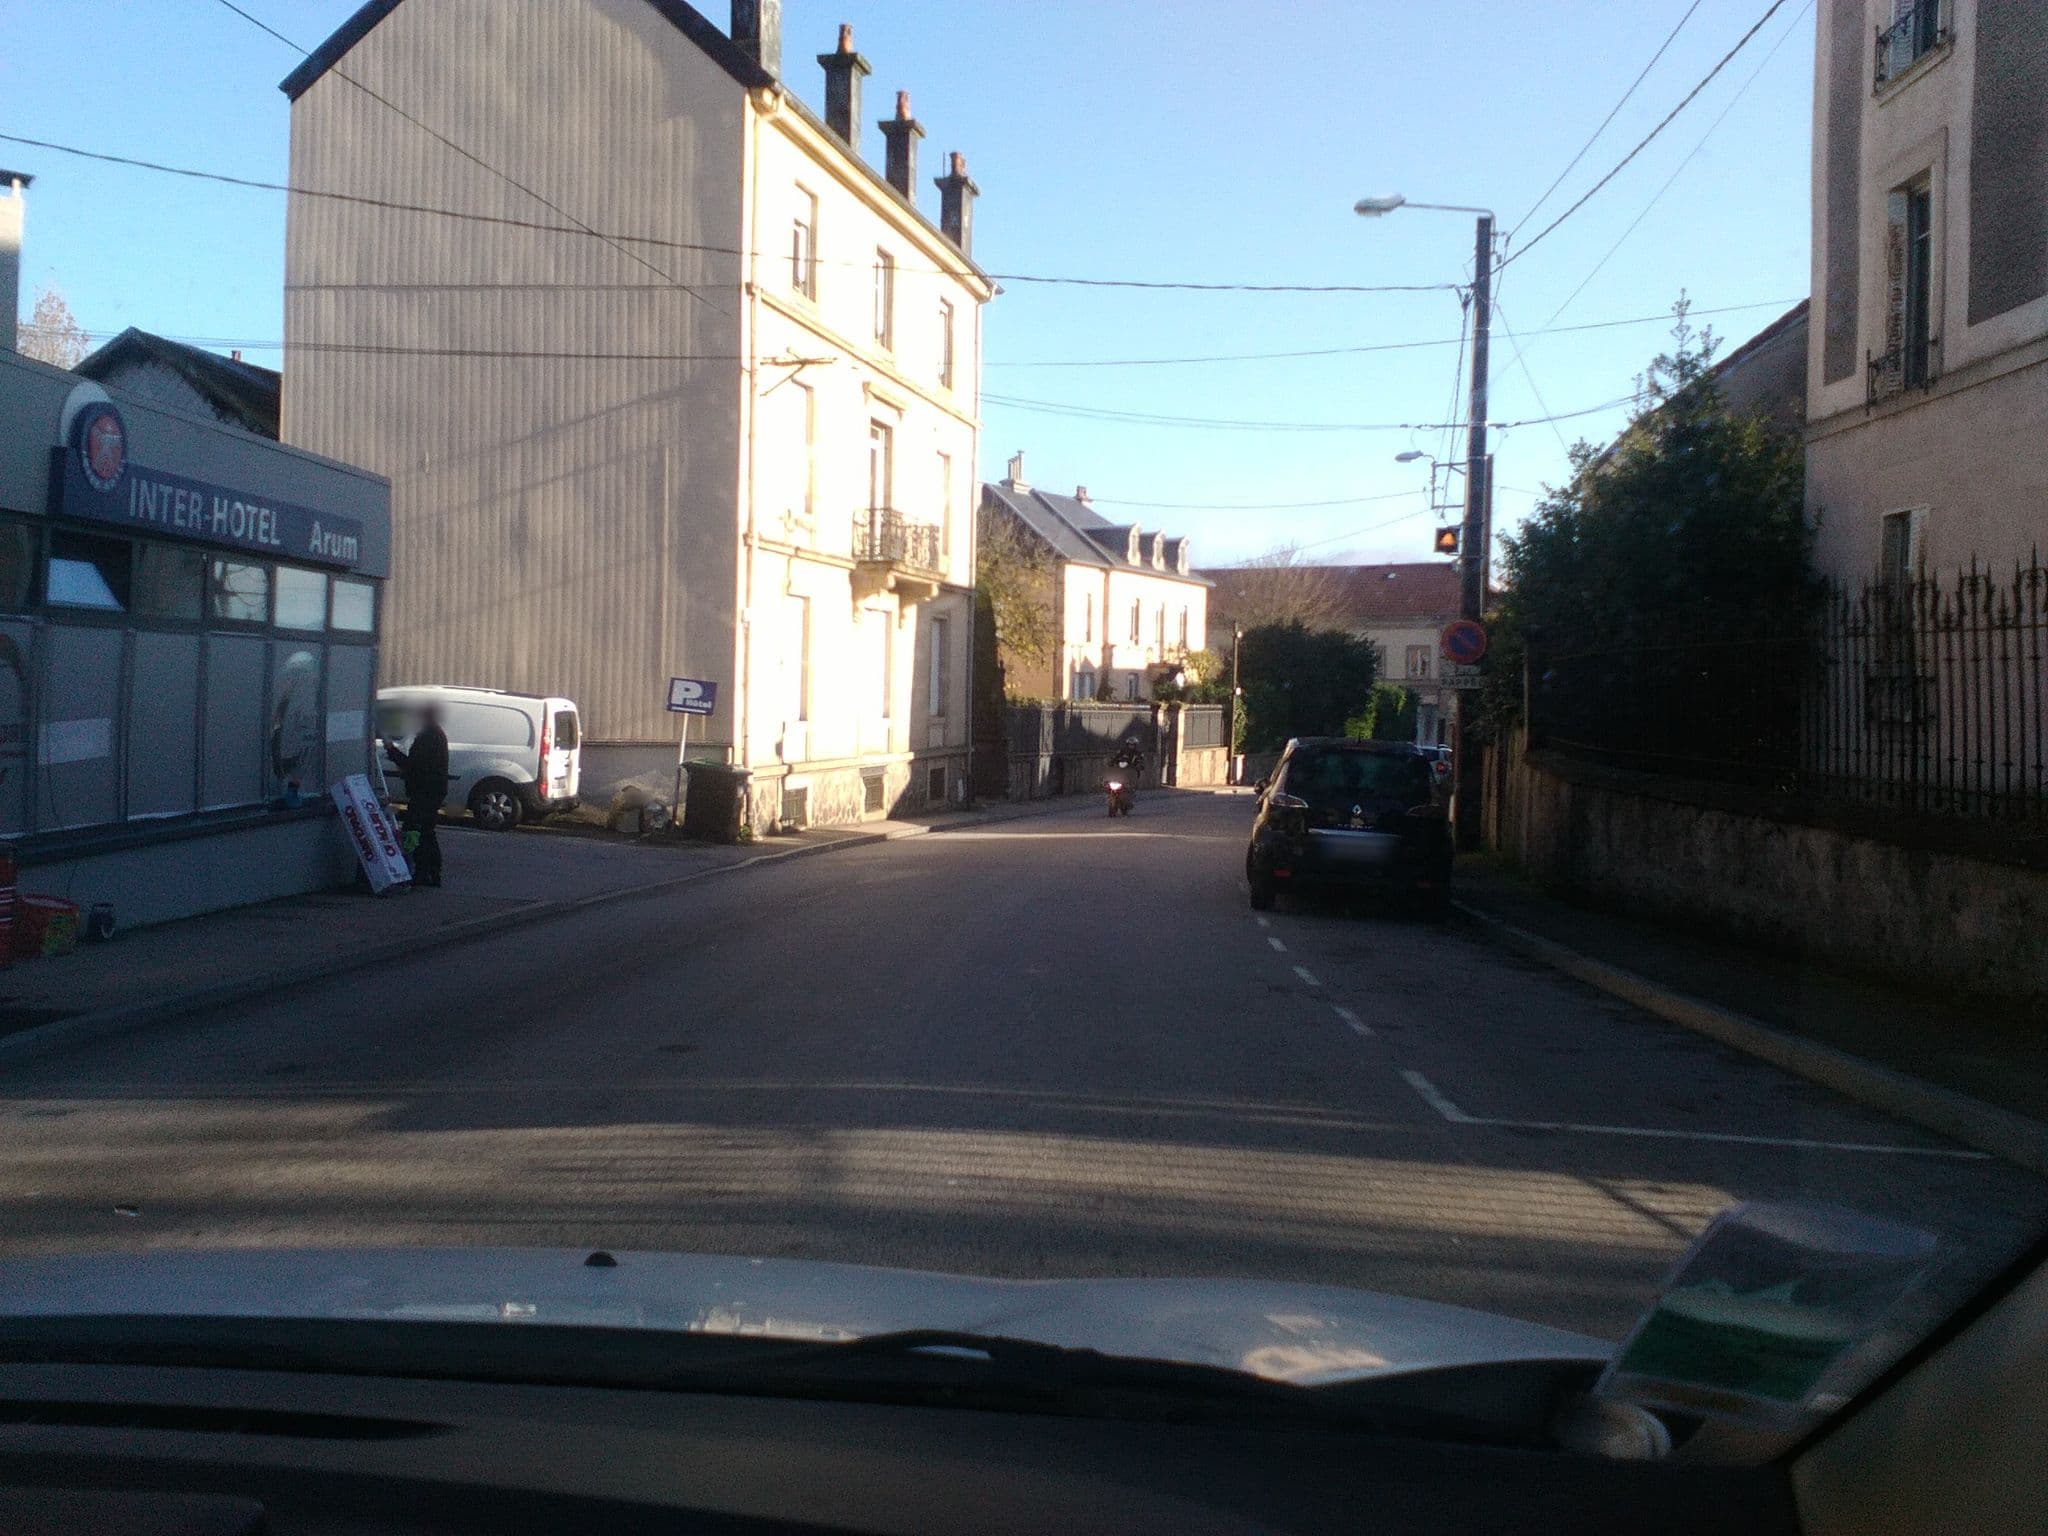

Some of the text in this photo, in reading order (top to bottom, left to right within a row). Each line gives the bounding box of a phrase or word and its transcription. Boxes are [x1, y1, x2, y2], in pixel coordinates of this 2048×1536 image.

[128, 476, 358, 561] INTER-HOTEL Arum
[671, 679, 704, 705] P
